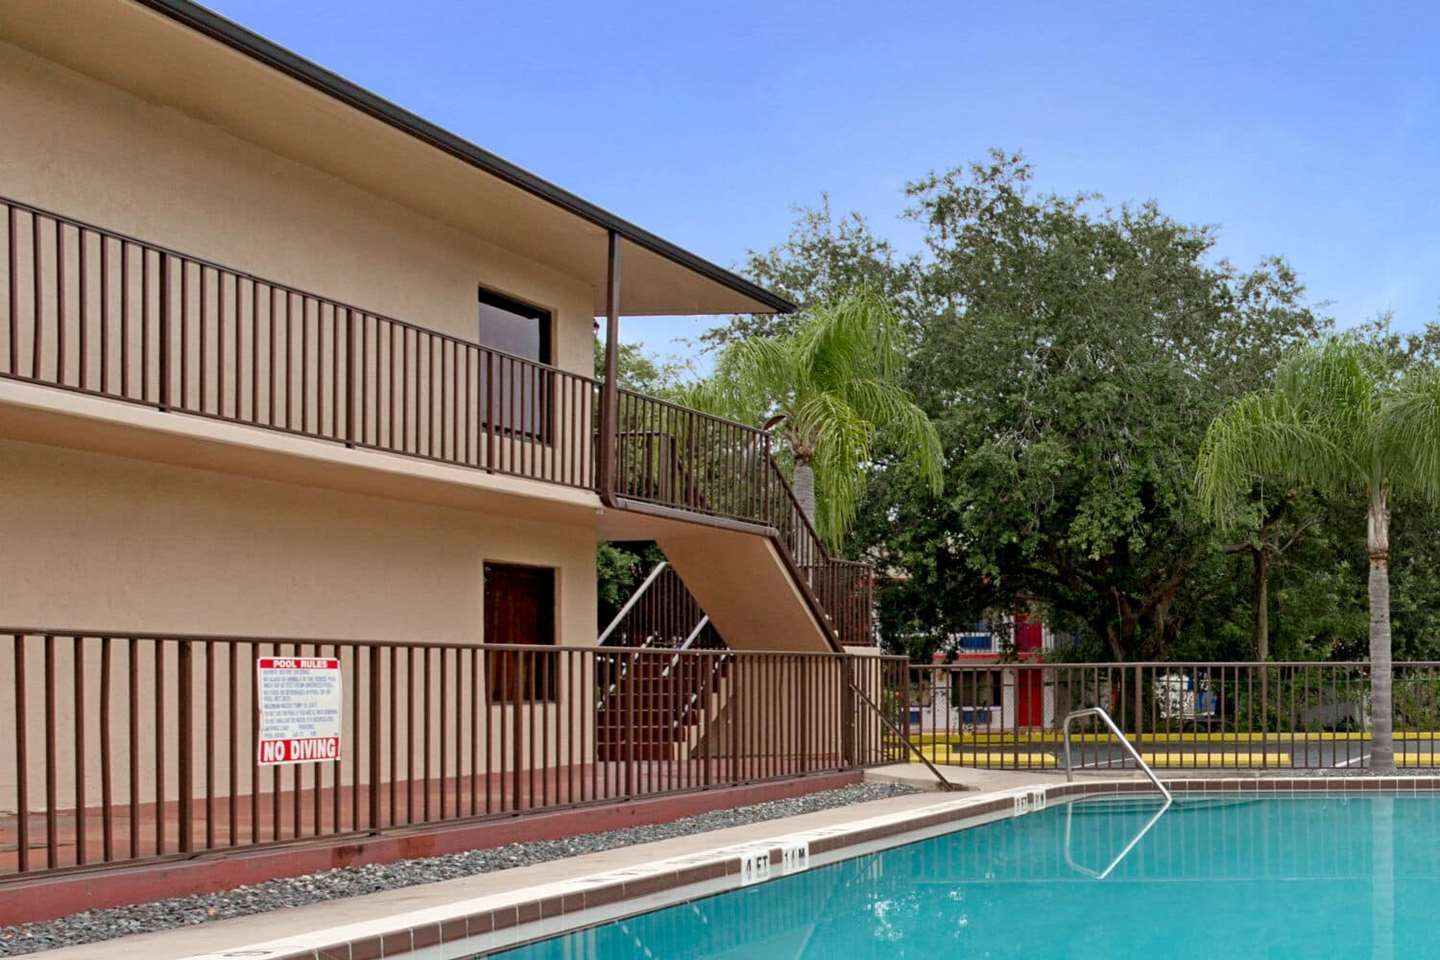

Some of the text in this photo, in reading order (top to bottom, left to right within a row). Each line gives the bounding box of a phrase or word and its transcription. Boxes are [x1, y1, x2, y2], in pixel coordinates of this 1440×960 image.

[273, 660, 327, 668] POOL RULES
[263, 739, 337, 762] NO DIVING
